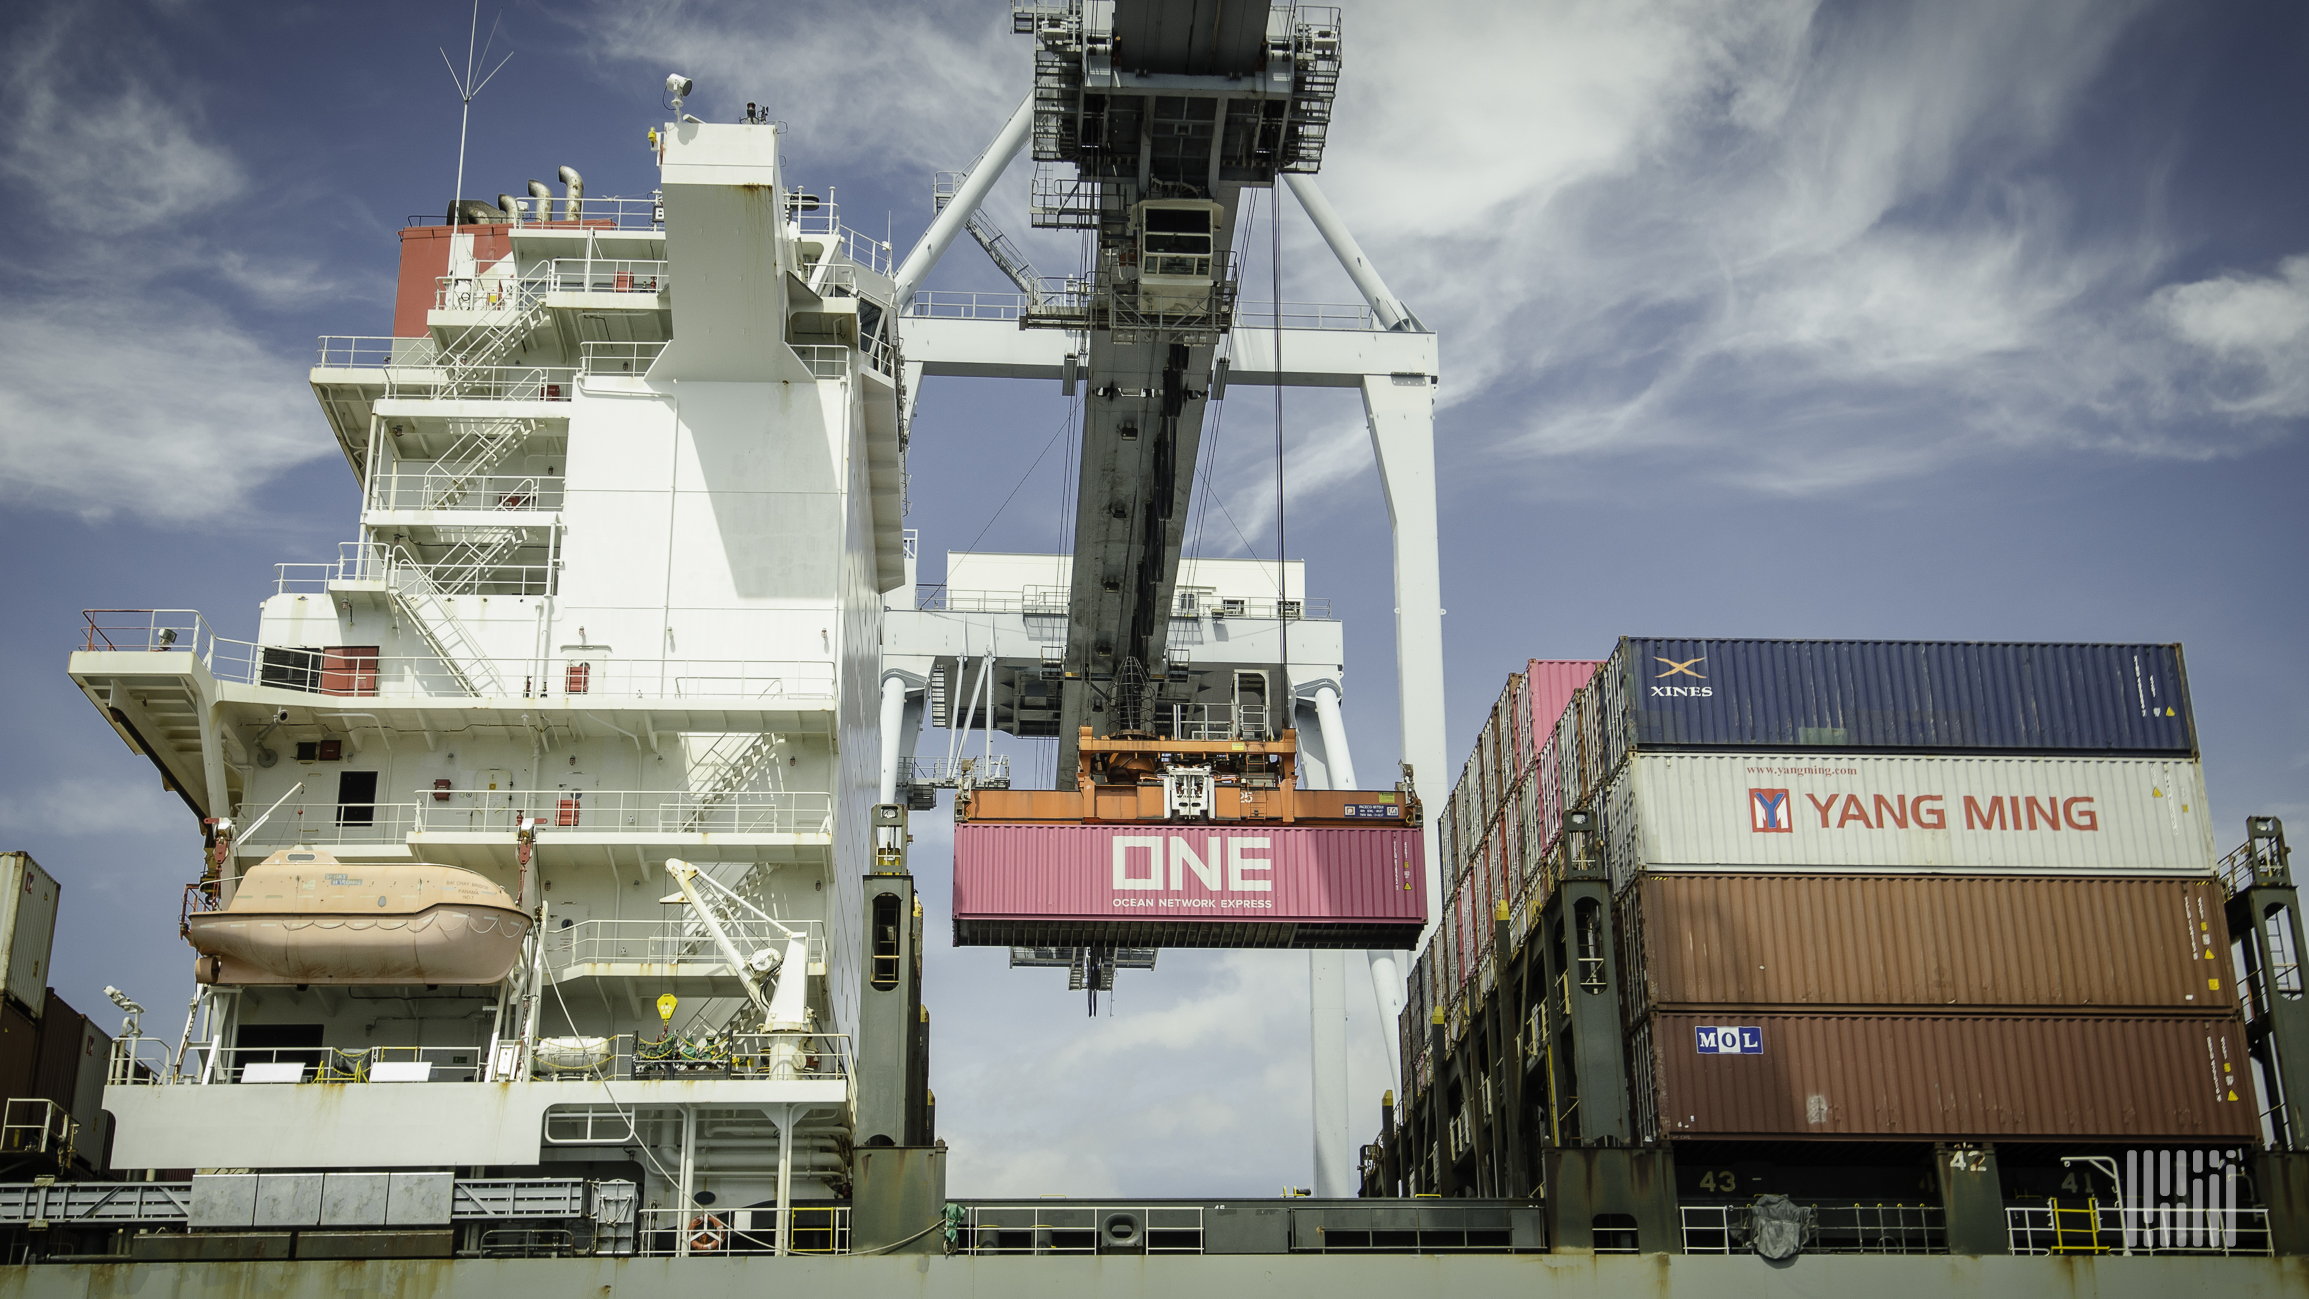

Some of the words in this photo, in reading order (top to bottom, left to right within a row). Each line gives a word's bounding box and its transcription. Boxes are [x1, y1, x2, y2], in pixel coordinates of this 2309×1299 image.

[1650, 686, 1713, 697] XINES
[1746, 765, 1858, 777] www.yangming.com
[1805, 793, 1947, 830] YANG
[1963, 795, 2098, 831] MING
[1112, 835, 1272, 892] ONE
[1112, 898, 1154, 908] OCEAN
[1158, 898, 1216, 908] NETWORK
[1220, 899, 1272, 909] EXPRESS
[1698, 1032, 1759, 1048] MOL
[1949, 1150, 1988, 1172] 42
[1699, 1170, 1736, 1192] 43
[2061, 1171, 2095, 1194] 41
